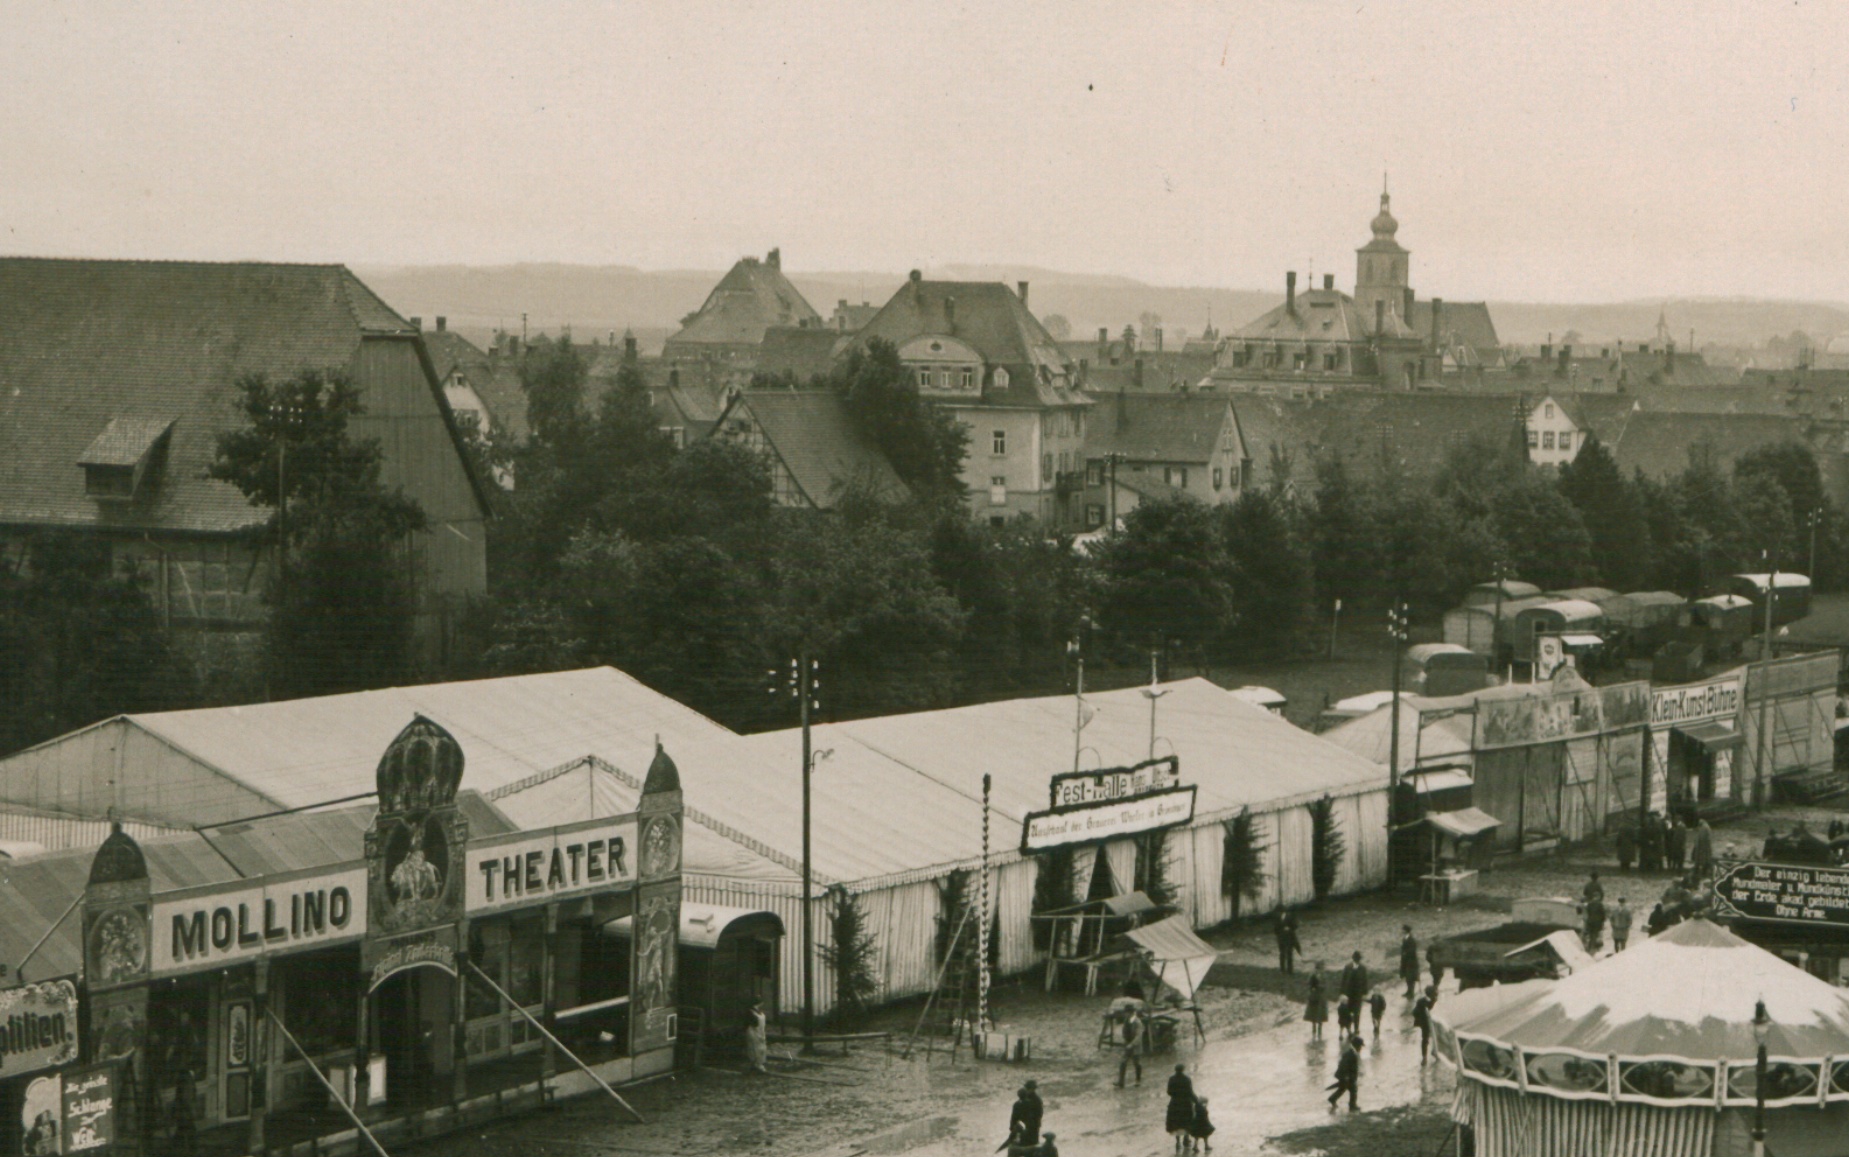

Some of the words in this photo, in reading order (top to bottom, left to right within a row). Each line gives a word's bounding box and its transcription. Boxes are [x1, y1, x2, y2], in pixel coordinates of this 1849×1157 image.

[1754, 866, 1771, 878] Der
[1776, 869, 1810, 883] einzig
[172, 886, 351, 961] MOLLINO
[479, 837, 628, 901] THEATER
[1732, 889, 1750, 901] der
[1776, 904, 1798, 917] Ohne
